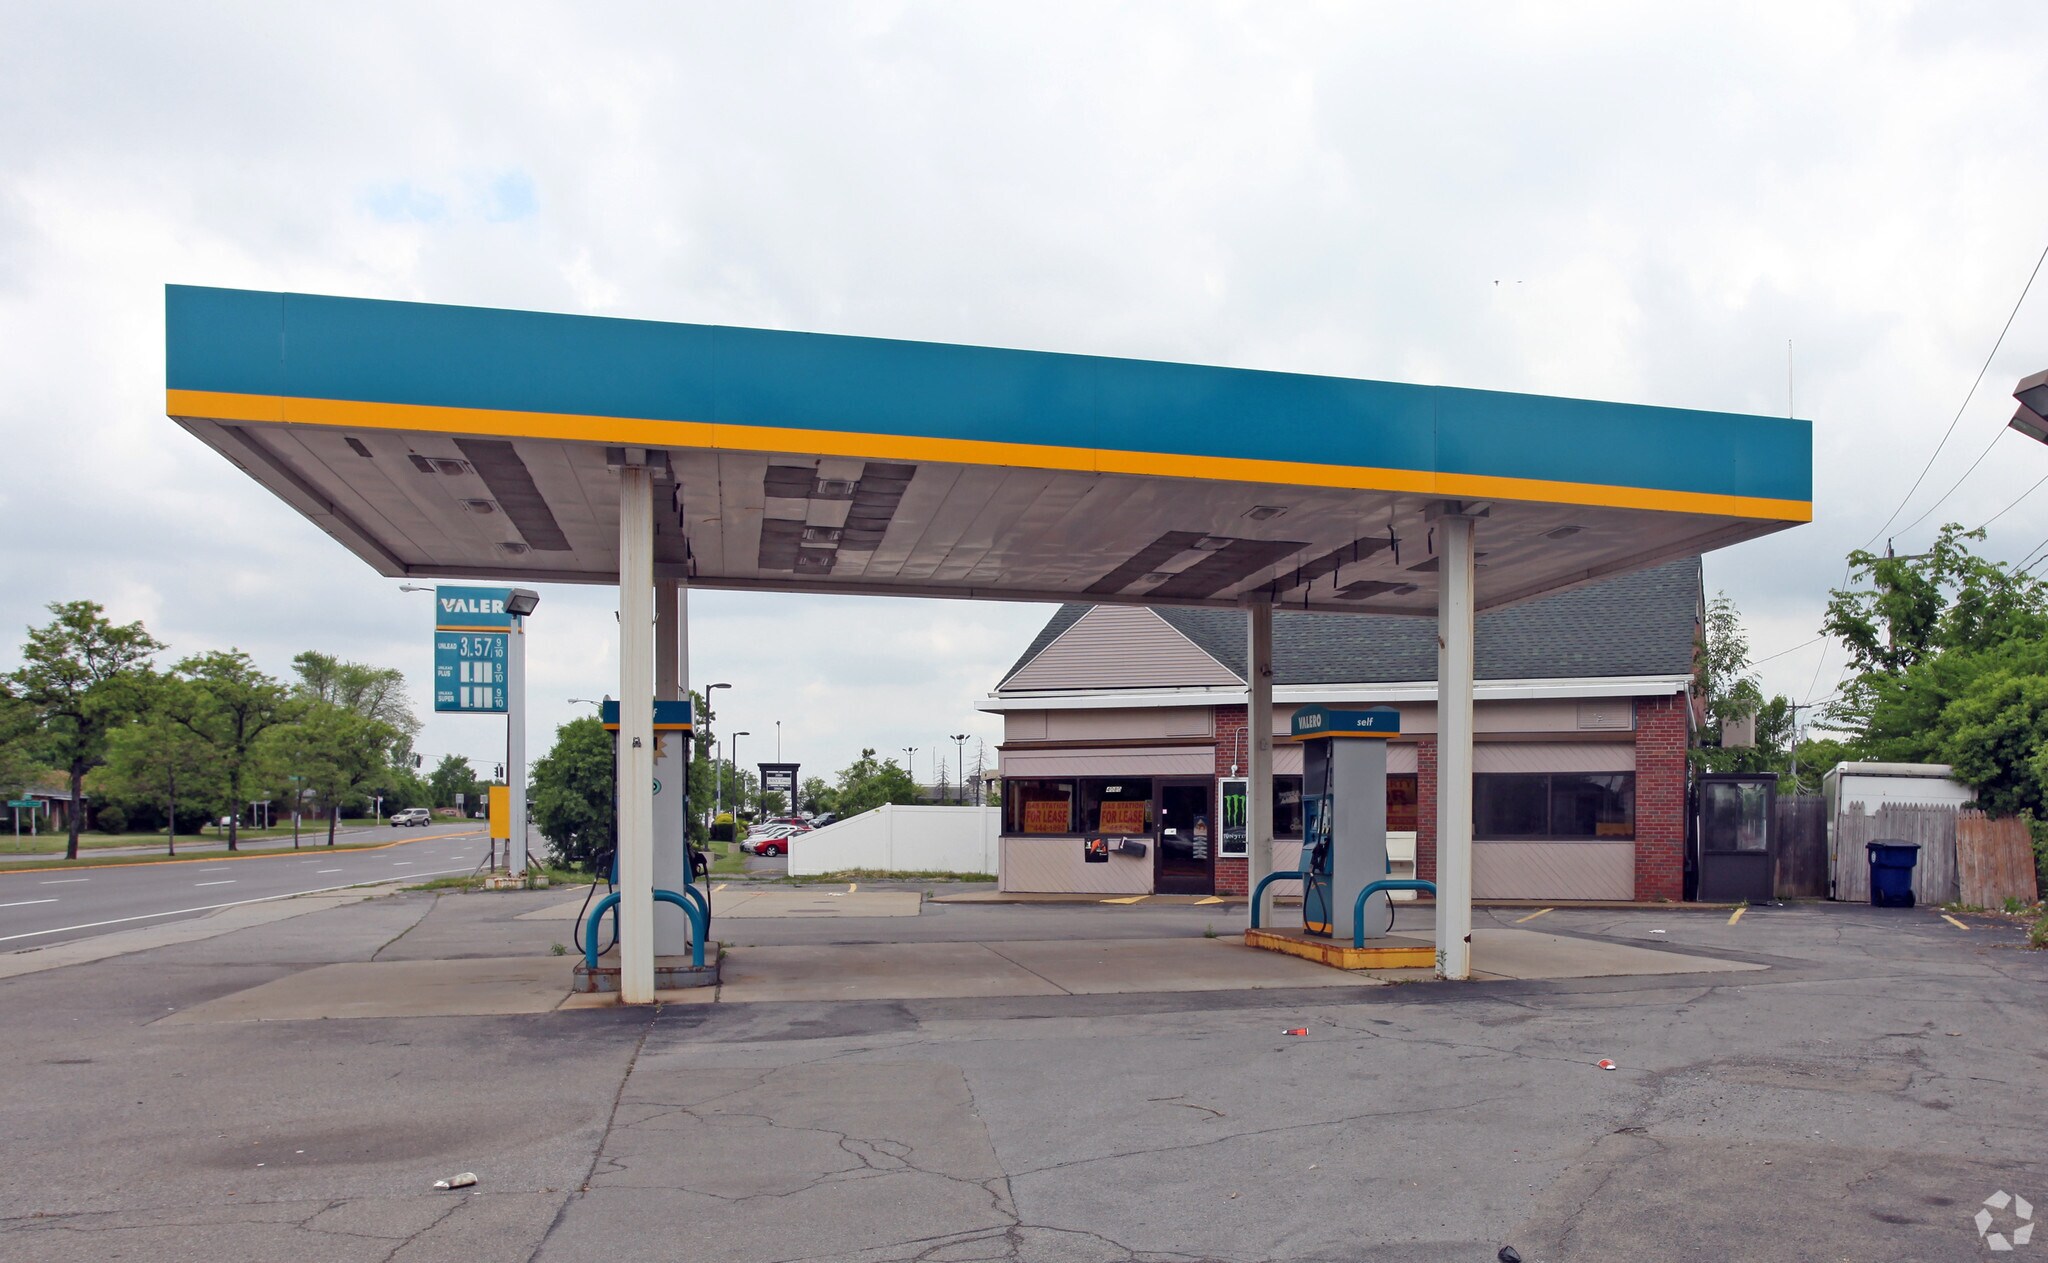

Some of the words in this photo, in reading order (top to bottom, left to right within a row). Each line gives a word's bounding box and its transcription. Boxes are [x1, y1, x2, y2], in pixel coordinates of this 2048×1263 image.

[441, 598, 504, 613] VALER
[1298, 713, 1322, 730] VALERO
[1357, 717, 1374, 726] self
[1026, 810, 1041, 823] FOR
[1043, 810, 1068, 823] LEASE
[1102, 811, 1117, 823] FOR
[1119, 810, 1143, 823] LEASE
